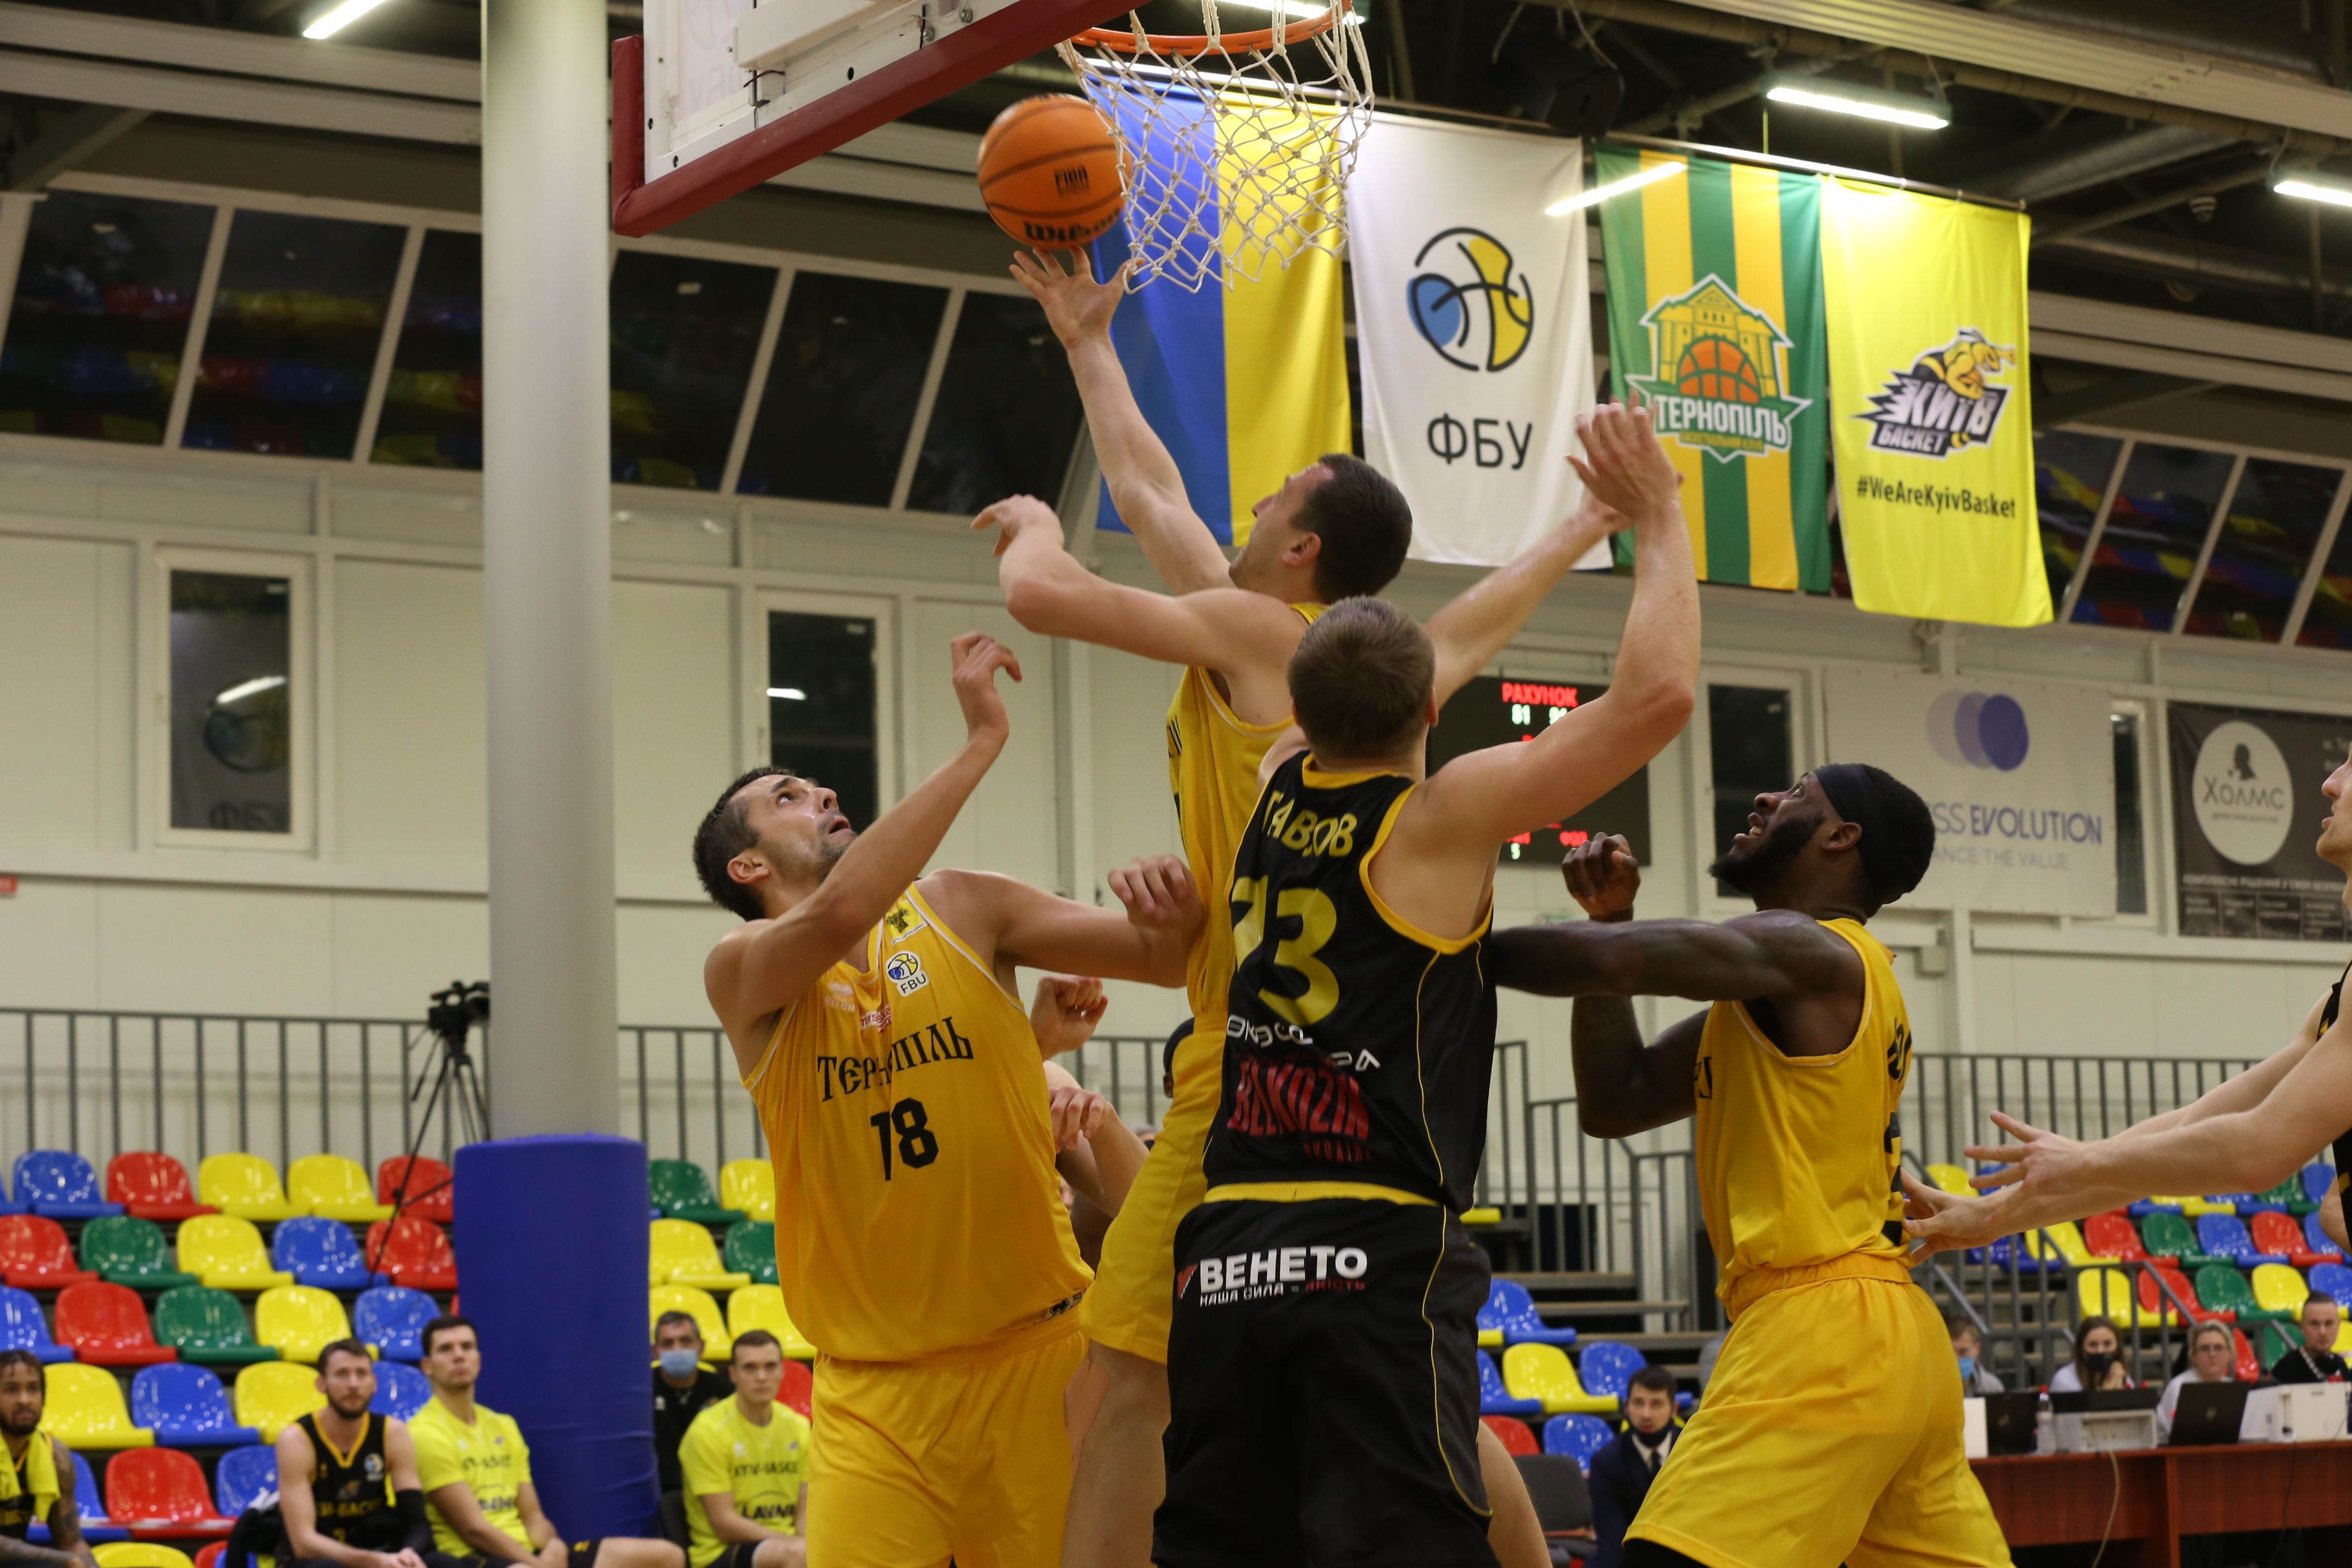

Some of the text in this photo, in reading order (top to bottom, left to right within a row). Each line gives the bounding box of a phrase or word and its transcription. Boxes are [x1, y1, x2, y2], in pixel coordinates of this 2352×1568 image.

[1654, 394, 1787, 446] ТЕРНОПІЛЬ
[1877, 423, 1948, 453] БАСКЕТ
[1427, 413, 1533, 470] ФБУ
[1857, 475, 2015, 518] #WeAreKyivBasket
[1502, 681, 1578, 708] РАХУНОК
[1932, 803, 2102, 845] SS EVOLUTION
[1934, 846, 1978, 866] ANCE
[1984, 848, 2015, 868] THE
[900, 974, 926, 994] FBU
[870, 1097, 939, 1181] 18
[1200, 1246, 1367, 1293] ВЕНЕТО
[1200, 1289, 1238, 1307] НАША
